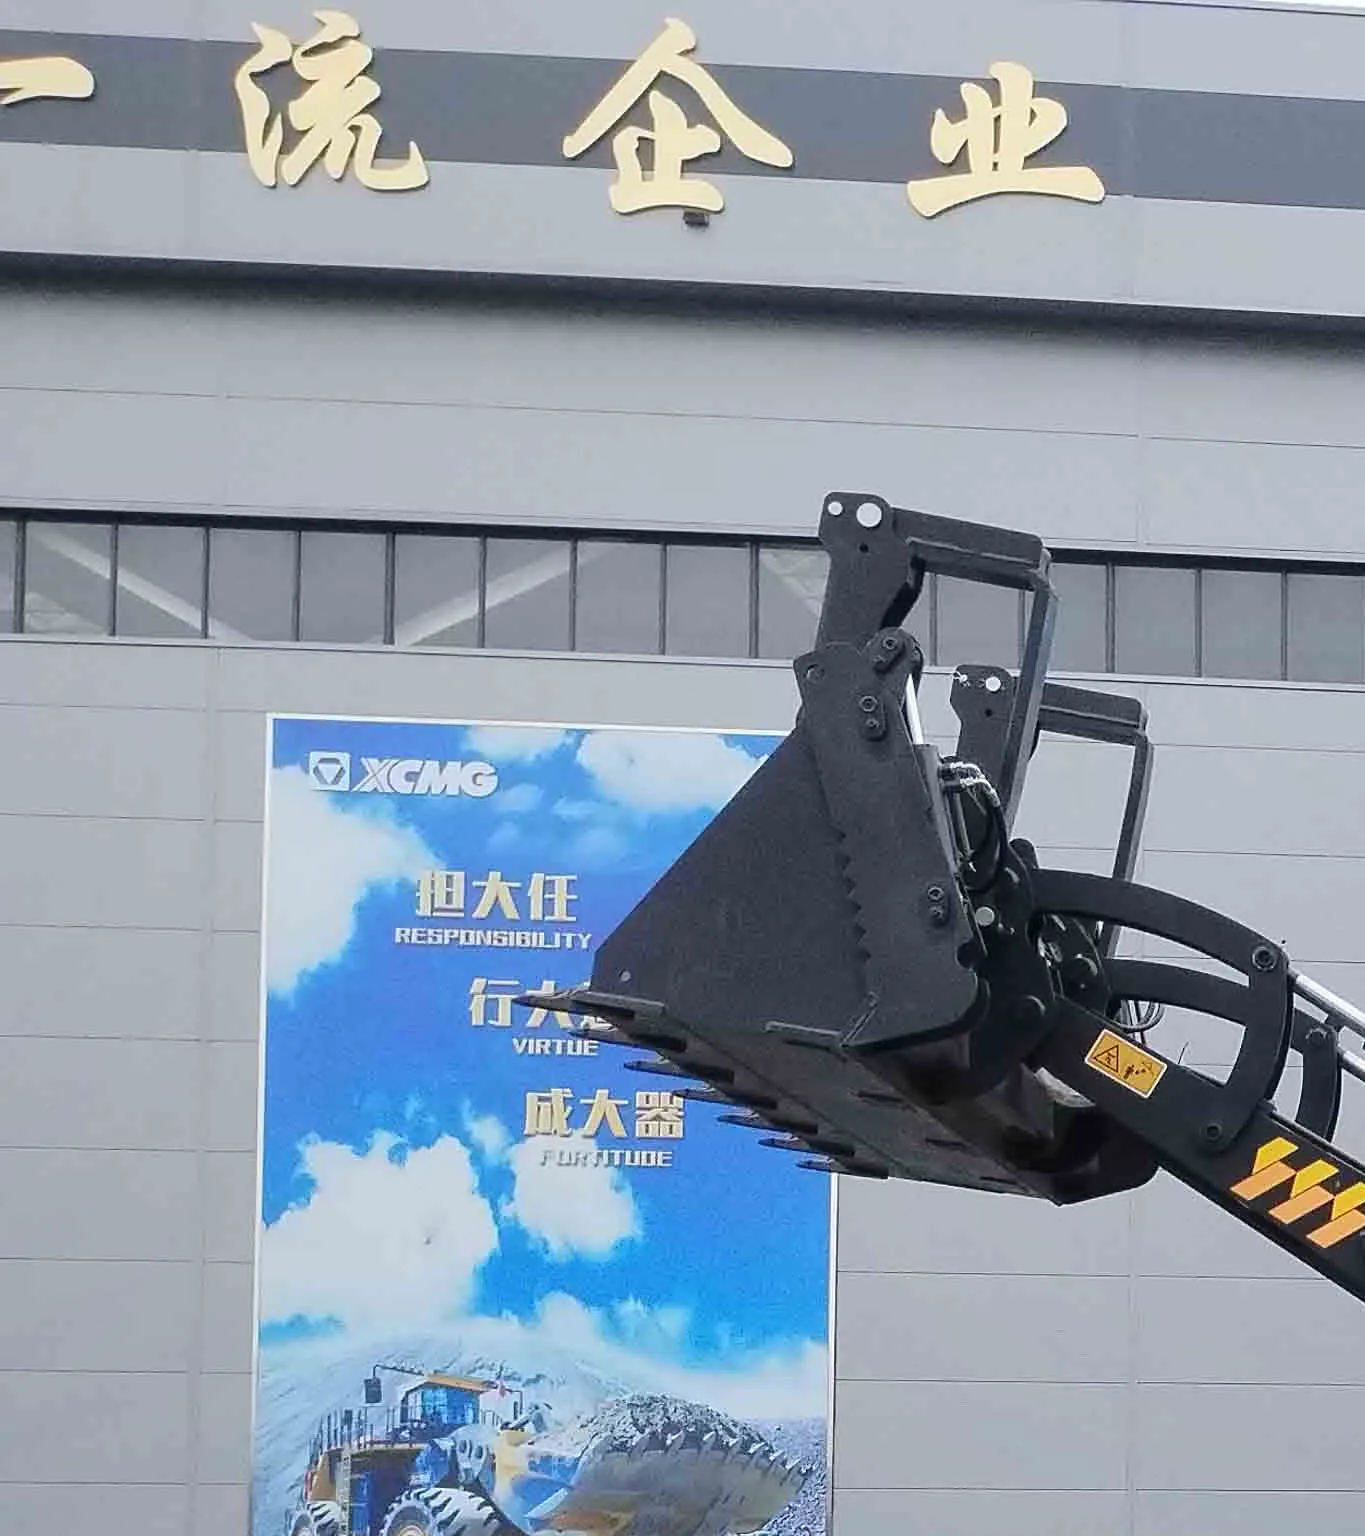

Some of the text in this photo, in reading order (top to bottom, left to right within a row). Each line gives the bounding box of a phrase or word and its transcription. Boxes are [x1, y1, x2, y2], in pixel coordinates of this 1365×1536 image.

[351, 756, 499, 798] XCMG
[415, 869, 578, 922] 担大任
[394, 926, 593, 949] RESPONSIBILITY
[468, 976, 618, 1032] 行大
[511, 1036, 600, 1056] VIRTUE
[523, 1087, 685, 1139] 成大器
[540, 1149, 673, 1168] FORTITUDE
